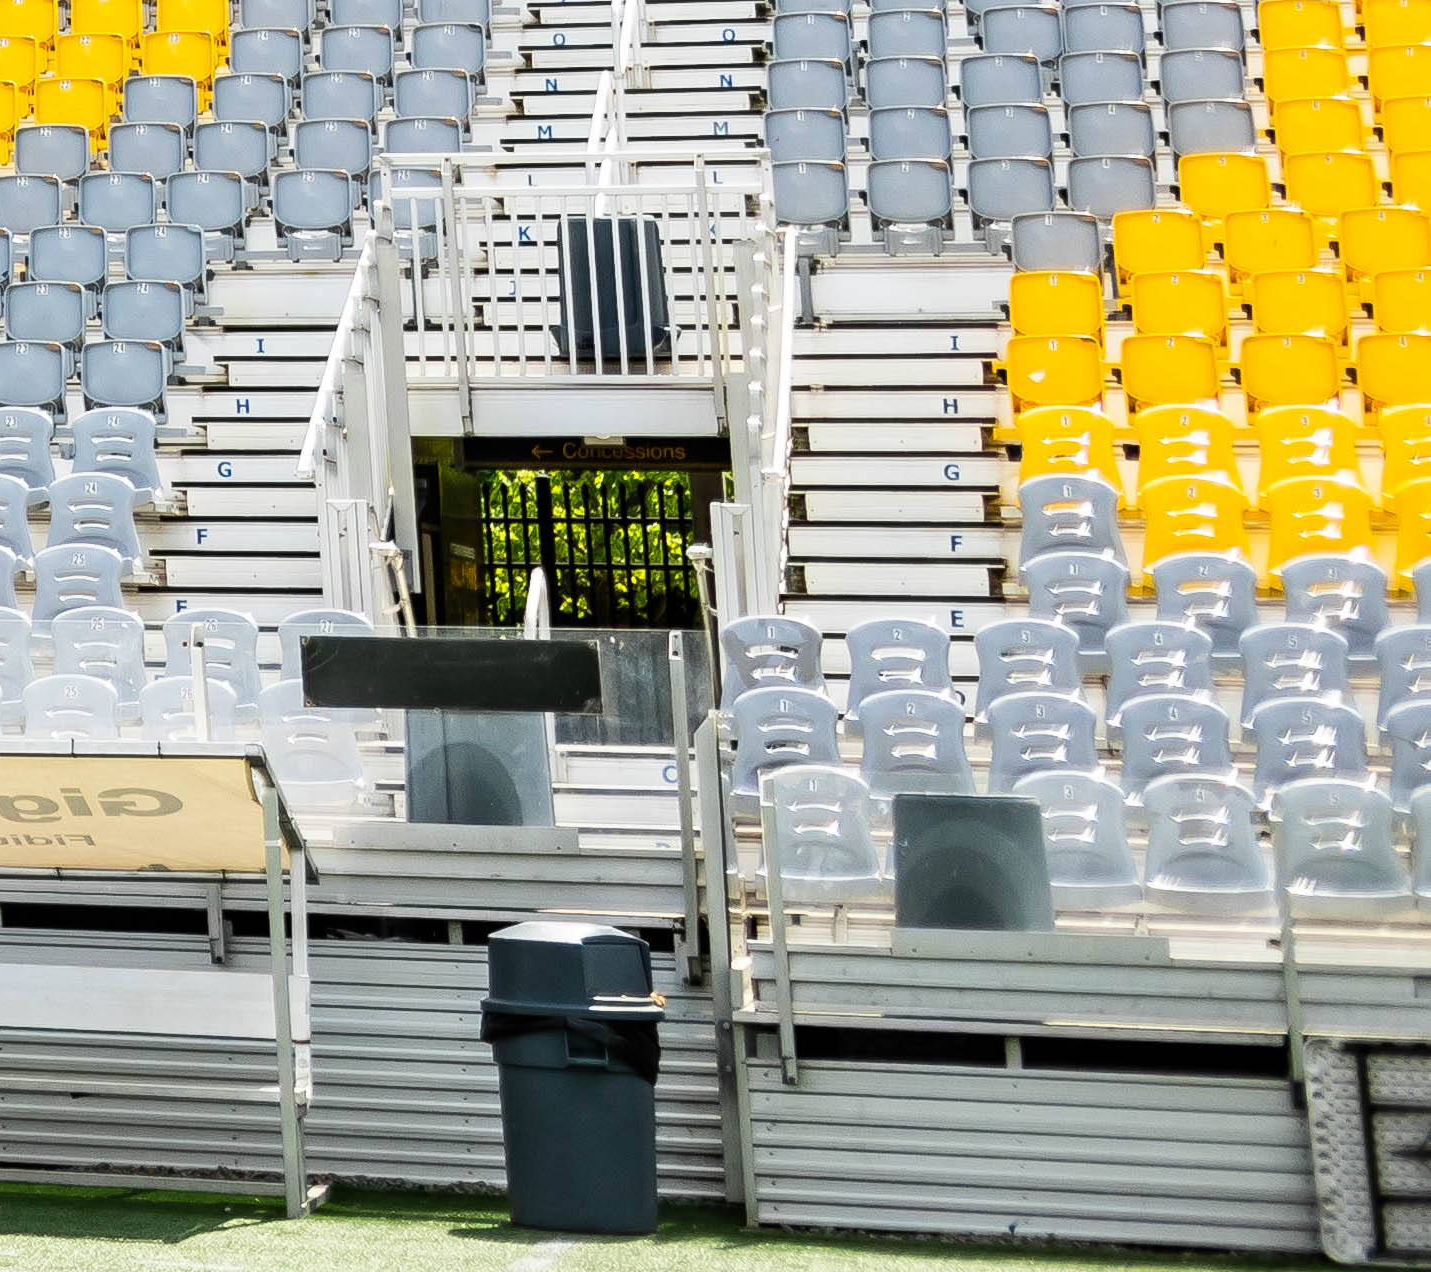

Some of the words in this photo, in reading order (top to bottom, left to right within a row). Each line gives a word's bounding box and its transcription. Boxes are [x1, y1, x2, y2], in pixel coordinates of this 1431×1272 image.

[546, 79, 557, 92] N
[720, 75, 732, 88] N
[538, 125, 552, 139] M
[714, 122, 728, 133] M
[198, 172, 211, 182] 24
[713, 171, 723, 184] L
[519, 227, 531, 240] K
[137, 282, 149, 292] 24
[16, 340, 28, 352] 23
[113, 340, 125, 352] 24
[257, 339, 264, 353] I
[952, 336, 959, 350] I
[237, 399, 249, 413] H
[944, 398, 958, 413] H
[108, 416, 119, 428] 24
[217, 462, 231, 477] G
[944, 464, 959, 480] G
[197, 529, 208, 544] F
[951, 536, 962, 552] F
[952, 610, 964, 627] E
[768, 626, 775, 638] 1
[893, 629, 902, 640] 2
[780, 700, 788, 712] 1
[907, 703, 915, 714] 2
[1036, 705, 1045, 717] 3
